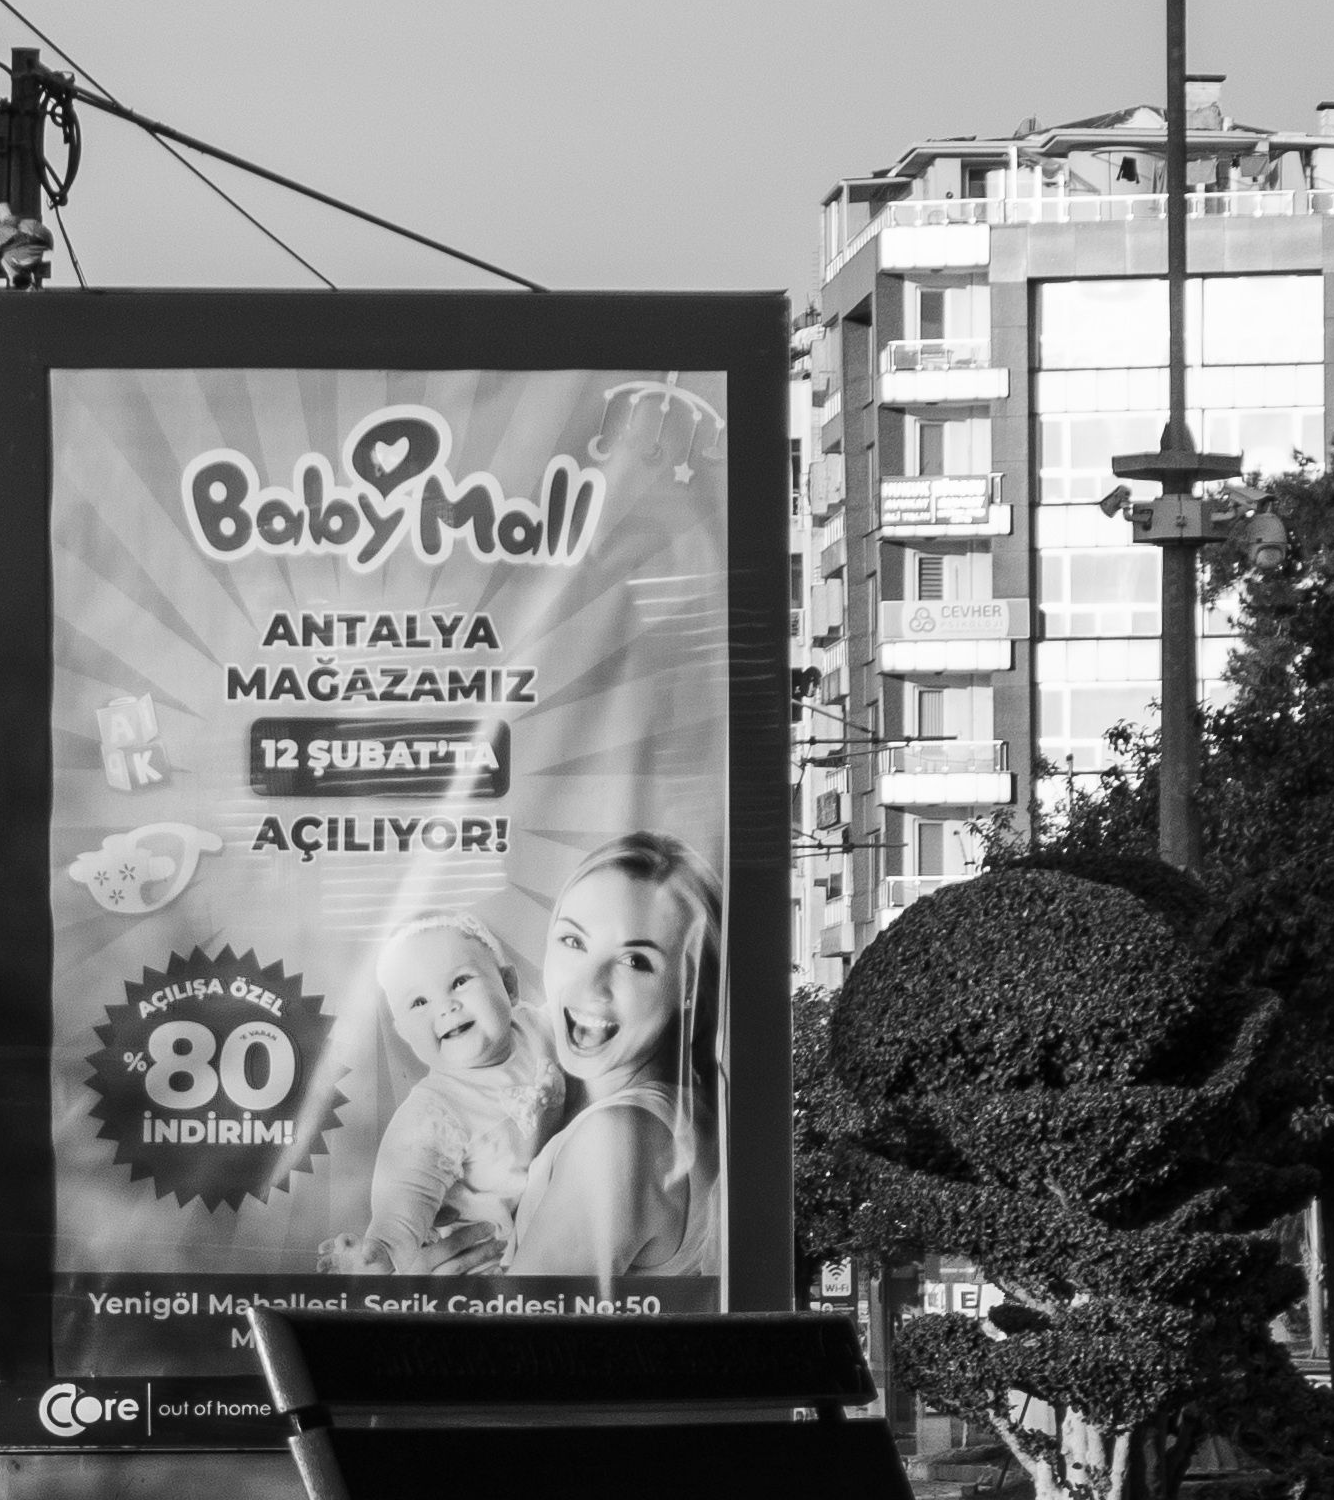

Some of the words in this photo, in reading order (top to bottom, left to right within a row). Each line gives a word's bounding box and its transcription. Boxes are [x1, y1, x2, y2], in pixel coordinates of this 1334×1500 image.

[941, 604, 1002, 618] CEVHER
[261, 612, 501, 649] ANTALYA
[226, 656, 536, 702] MAĞAZAMIZ
[260, 739, 300, 769] 12
[306, 739, 500, 777] ŞUBAT'TA
[251, 815, 509, 863] AÇILIYOR!
[138, 977, 224, 1019] AÇILIŞA
[229, 975, 283, 1018] ÖZEL
[142, 1109, 295, 1145] İNDİRİM!
[88, 1290, 199, 1320] Yenigöl
[364, 1293, 438, 1314] Serik
[447, 1293, 565, 1315] Caddesi
[574, 1295, 661, 1315] No:50
[158, 1402, 189, 1417] out
[194, 1400, 213, 1417] of
[216, 1400, 272, 1417] home
